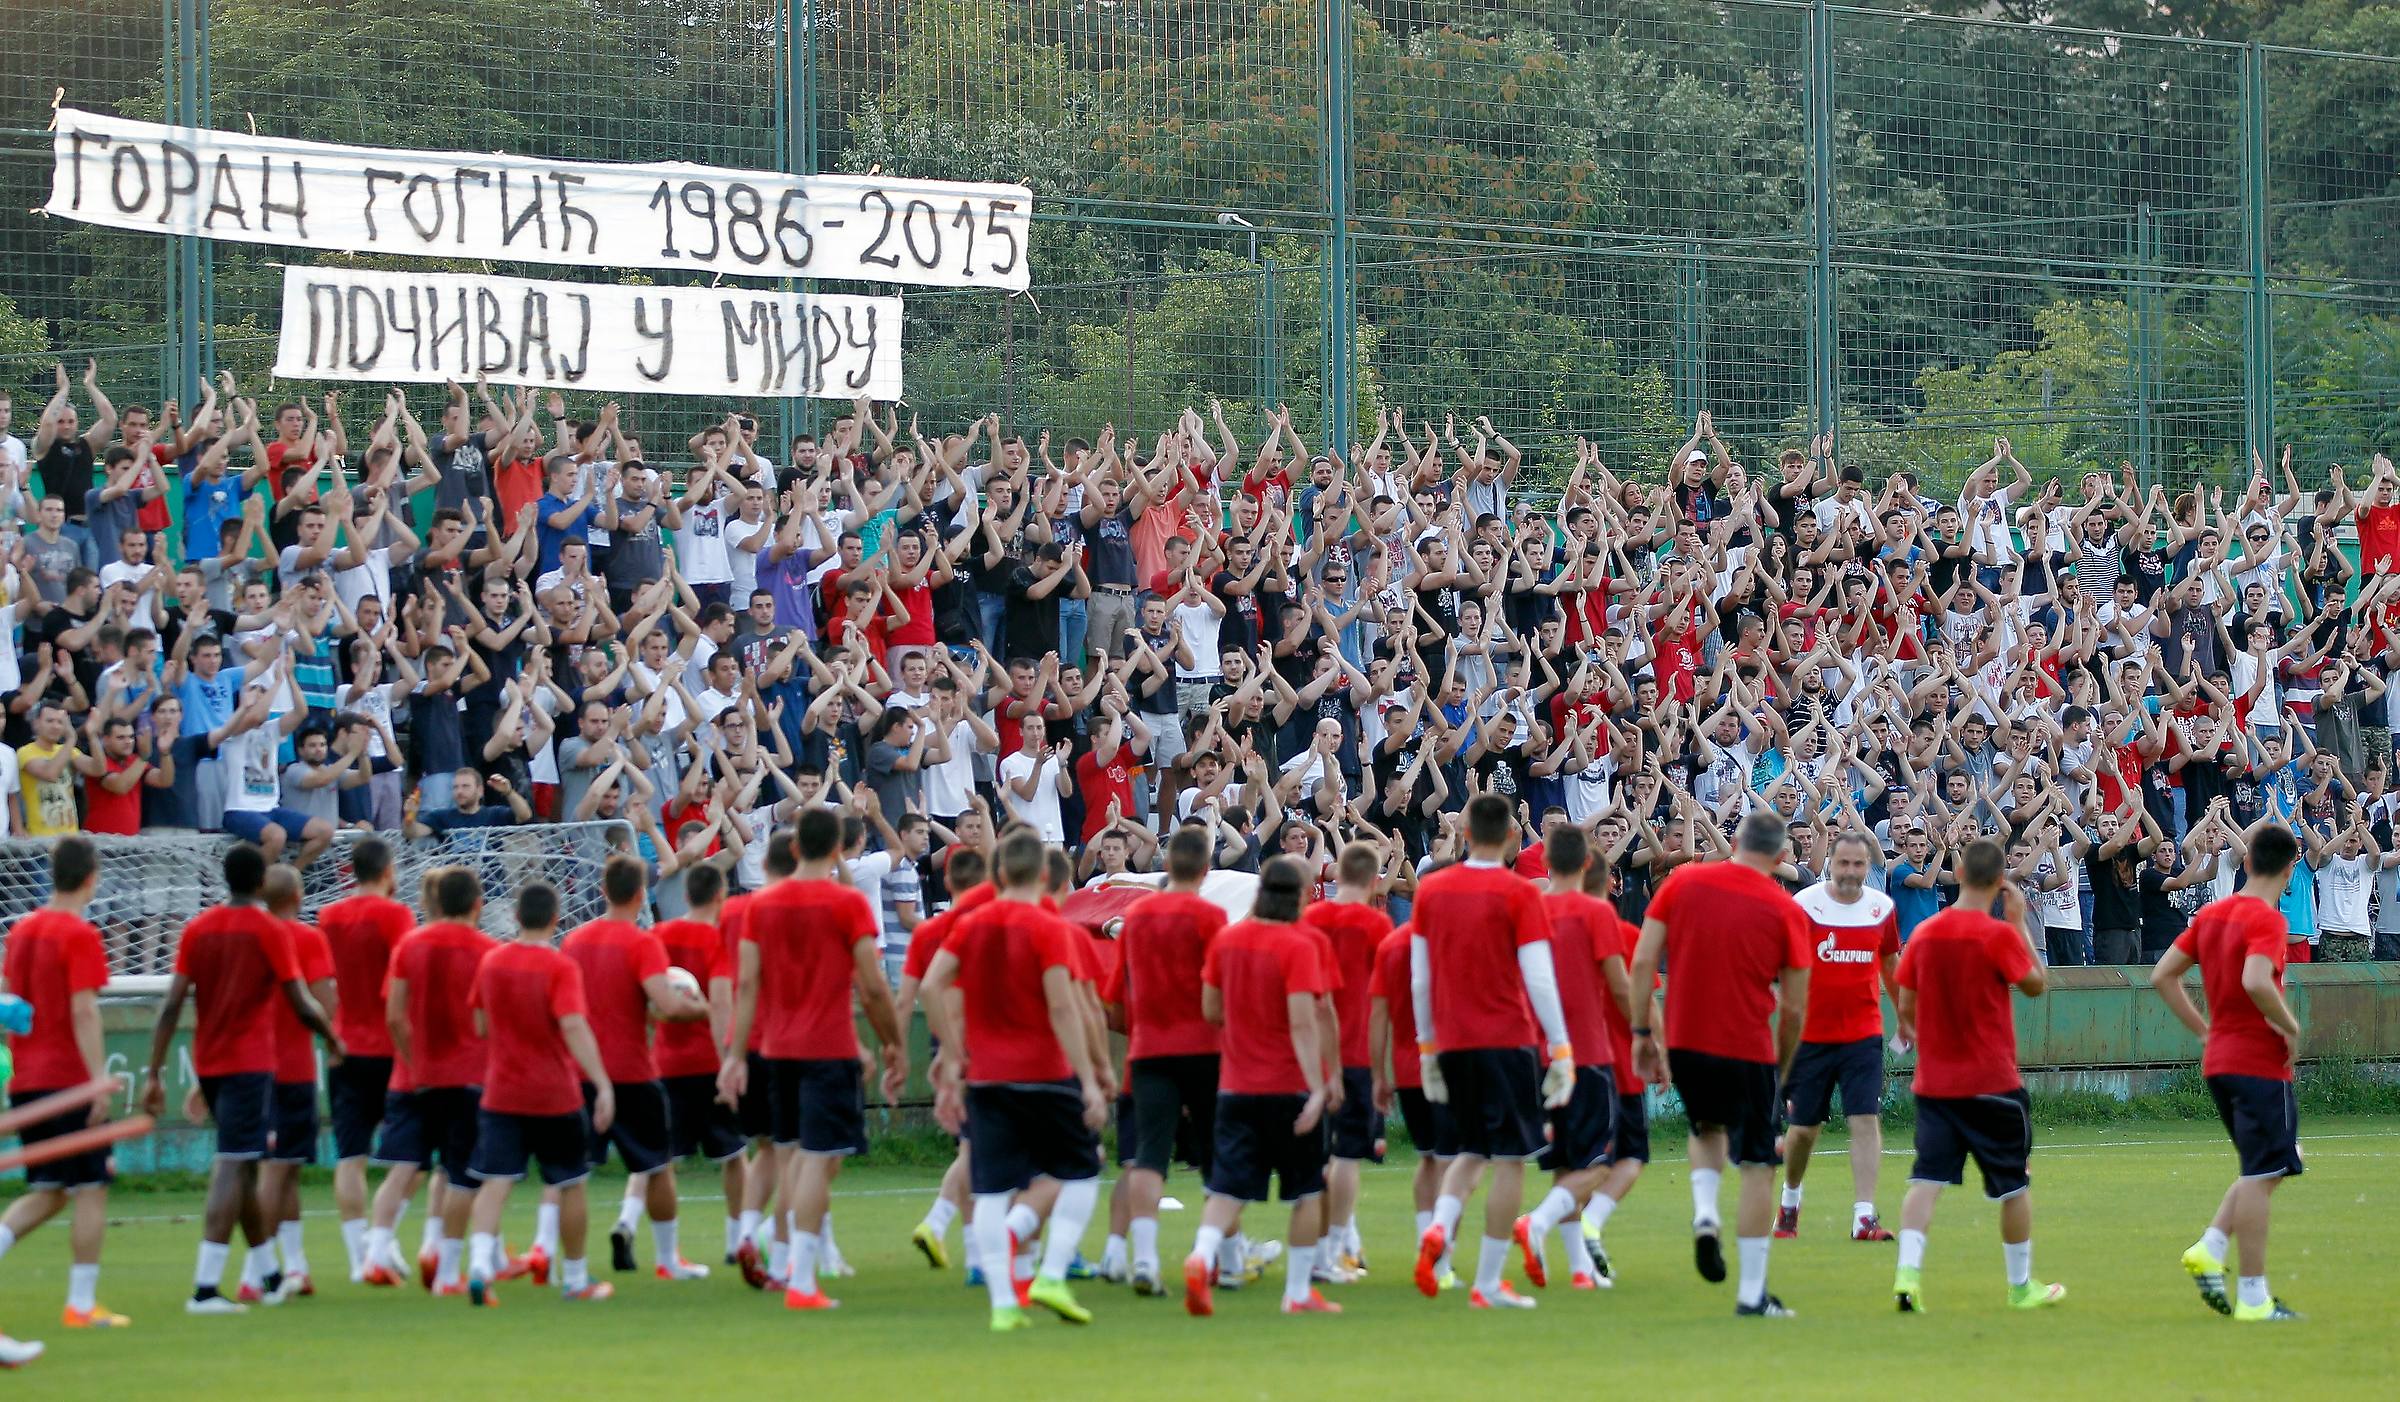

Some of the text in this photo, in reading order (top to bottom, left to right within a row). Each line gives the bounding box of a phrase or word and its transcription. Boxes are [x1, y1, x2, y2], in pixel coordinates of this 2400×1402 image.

[70, 129, 308, 238] ГОРАН
[364, 167, 597, 255] ГОГИЋ
[306, 283, 877, 393] ПОЧИВАЈ У МИРУ
